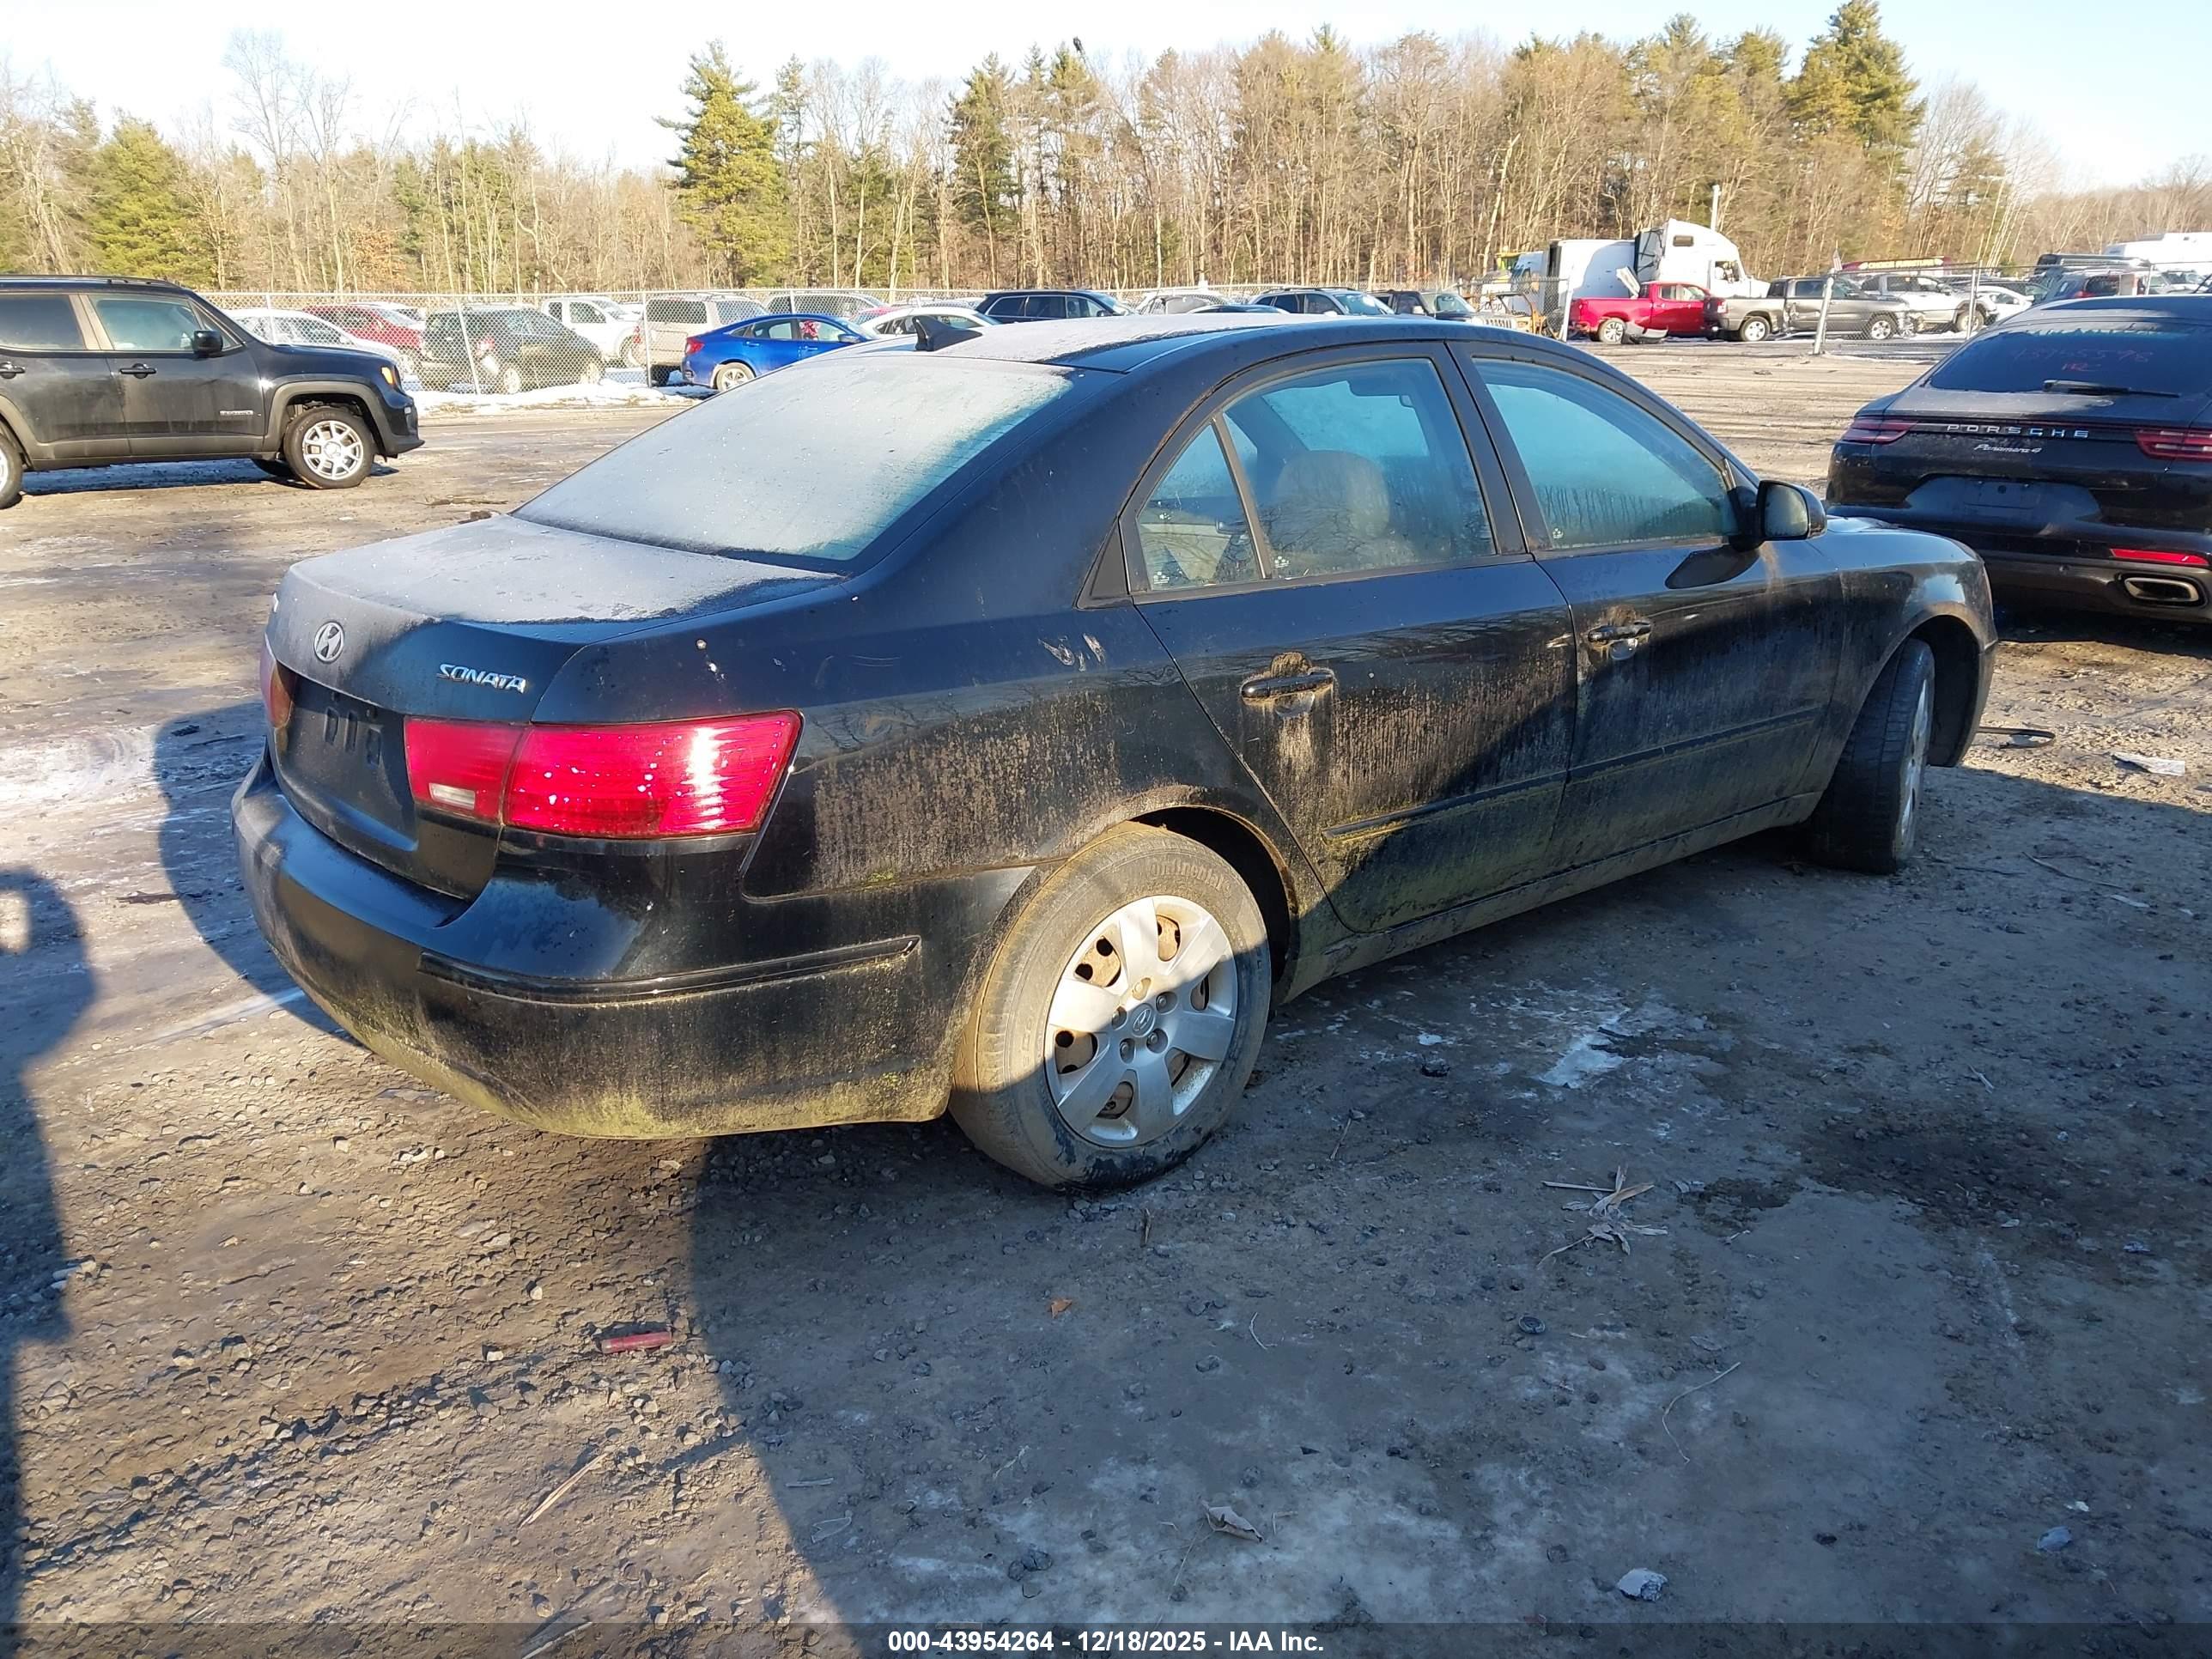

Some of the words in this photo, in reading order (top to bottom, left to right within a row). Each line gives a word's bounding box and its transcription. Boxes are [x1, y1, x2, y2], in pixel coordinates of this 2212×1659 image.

[1947, 424, 2089, 439] PORSCHE
[1974, 443, 2030, 453] Panamera
[436, 663, 526, 694] SONATA
